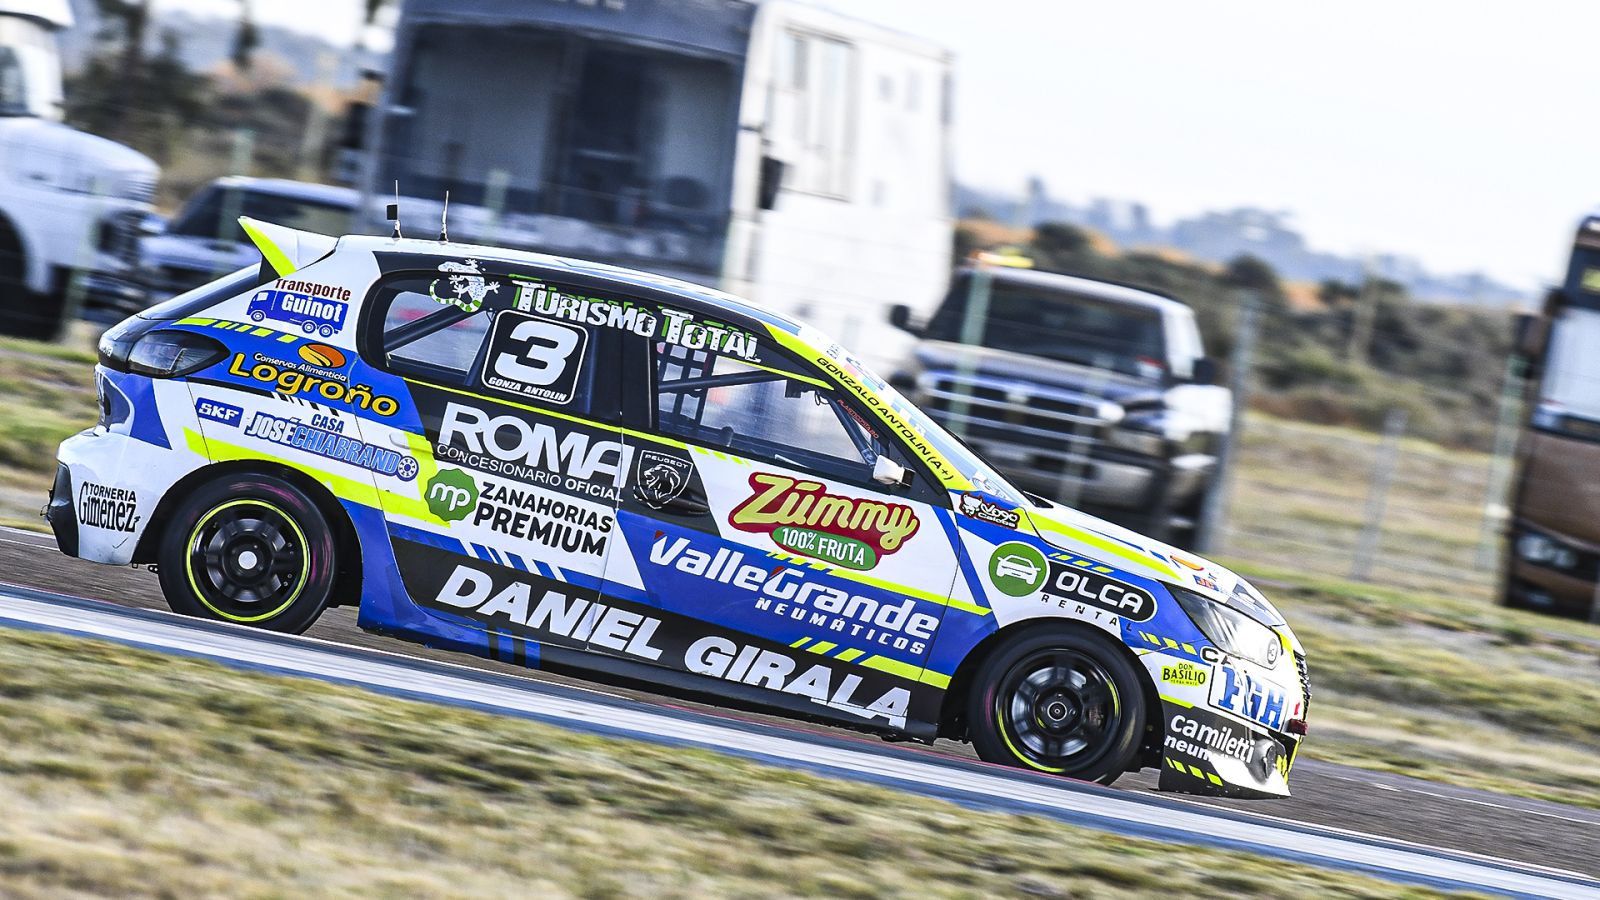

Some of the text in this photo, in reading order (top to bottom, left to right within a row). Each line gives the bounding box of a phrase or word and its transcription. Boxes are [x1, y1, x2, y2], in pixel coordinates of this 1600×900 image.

[275, 278, 351, 301] Transporte
[281, 293, 343, 323] Guinot
[513, 280, 761, 362] TURISMO TOTAL
[254, 352, 297, 369] Conservas
[494, 320, 578, 386] 3
[229, 353, 397, 417] Logroño
[488, 376, 567, 402] GONZA ANTOLIN
[816, 357, 880, 406] GONZALO
[877, 407, 930, 456] ANTOLIN
[199, 403, 239, 420] SKF
[311, 413, 345, 433] CASA
[438, 402, 635, 489] ROMA
[645, 454, 688, 469] PEUGEOT
[90, 484, 137, 502] TORNERIA
[437, 443, 623, 502] CONCESIONARIO OFICIAL
[79, 481, 138, 533] Gimenez
[473, 502, 607, 557] PREMIUM
[480, 482, 614, 533] ZANAHORIAS
[782, 528, 864, 565] 100% FRUTA
[1041, 594, 1132, 631] RENTAL
[1055, 571, 1144, 614] OLCA
[435, 565, 912, 729] DANIEL GIRALA
[755, 597, 926, 655] NEUMÁTICOS
[1163, 668, 1205, 685] BASILIO
[1170, 715, 1255, 763] camiletti
